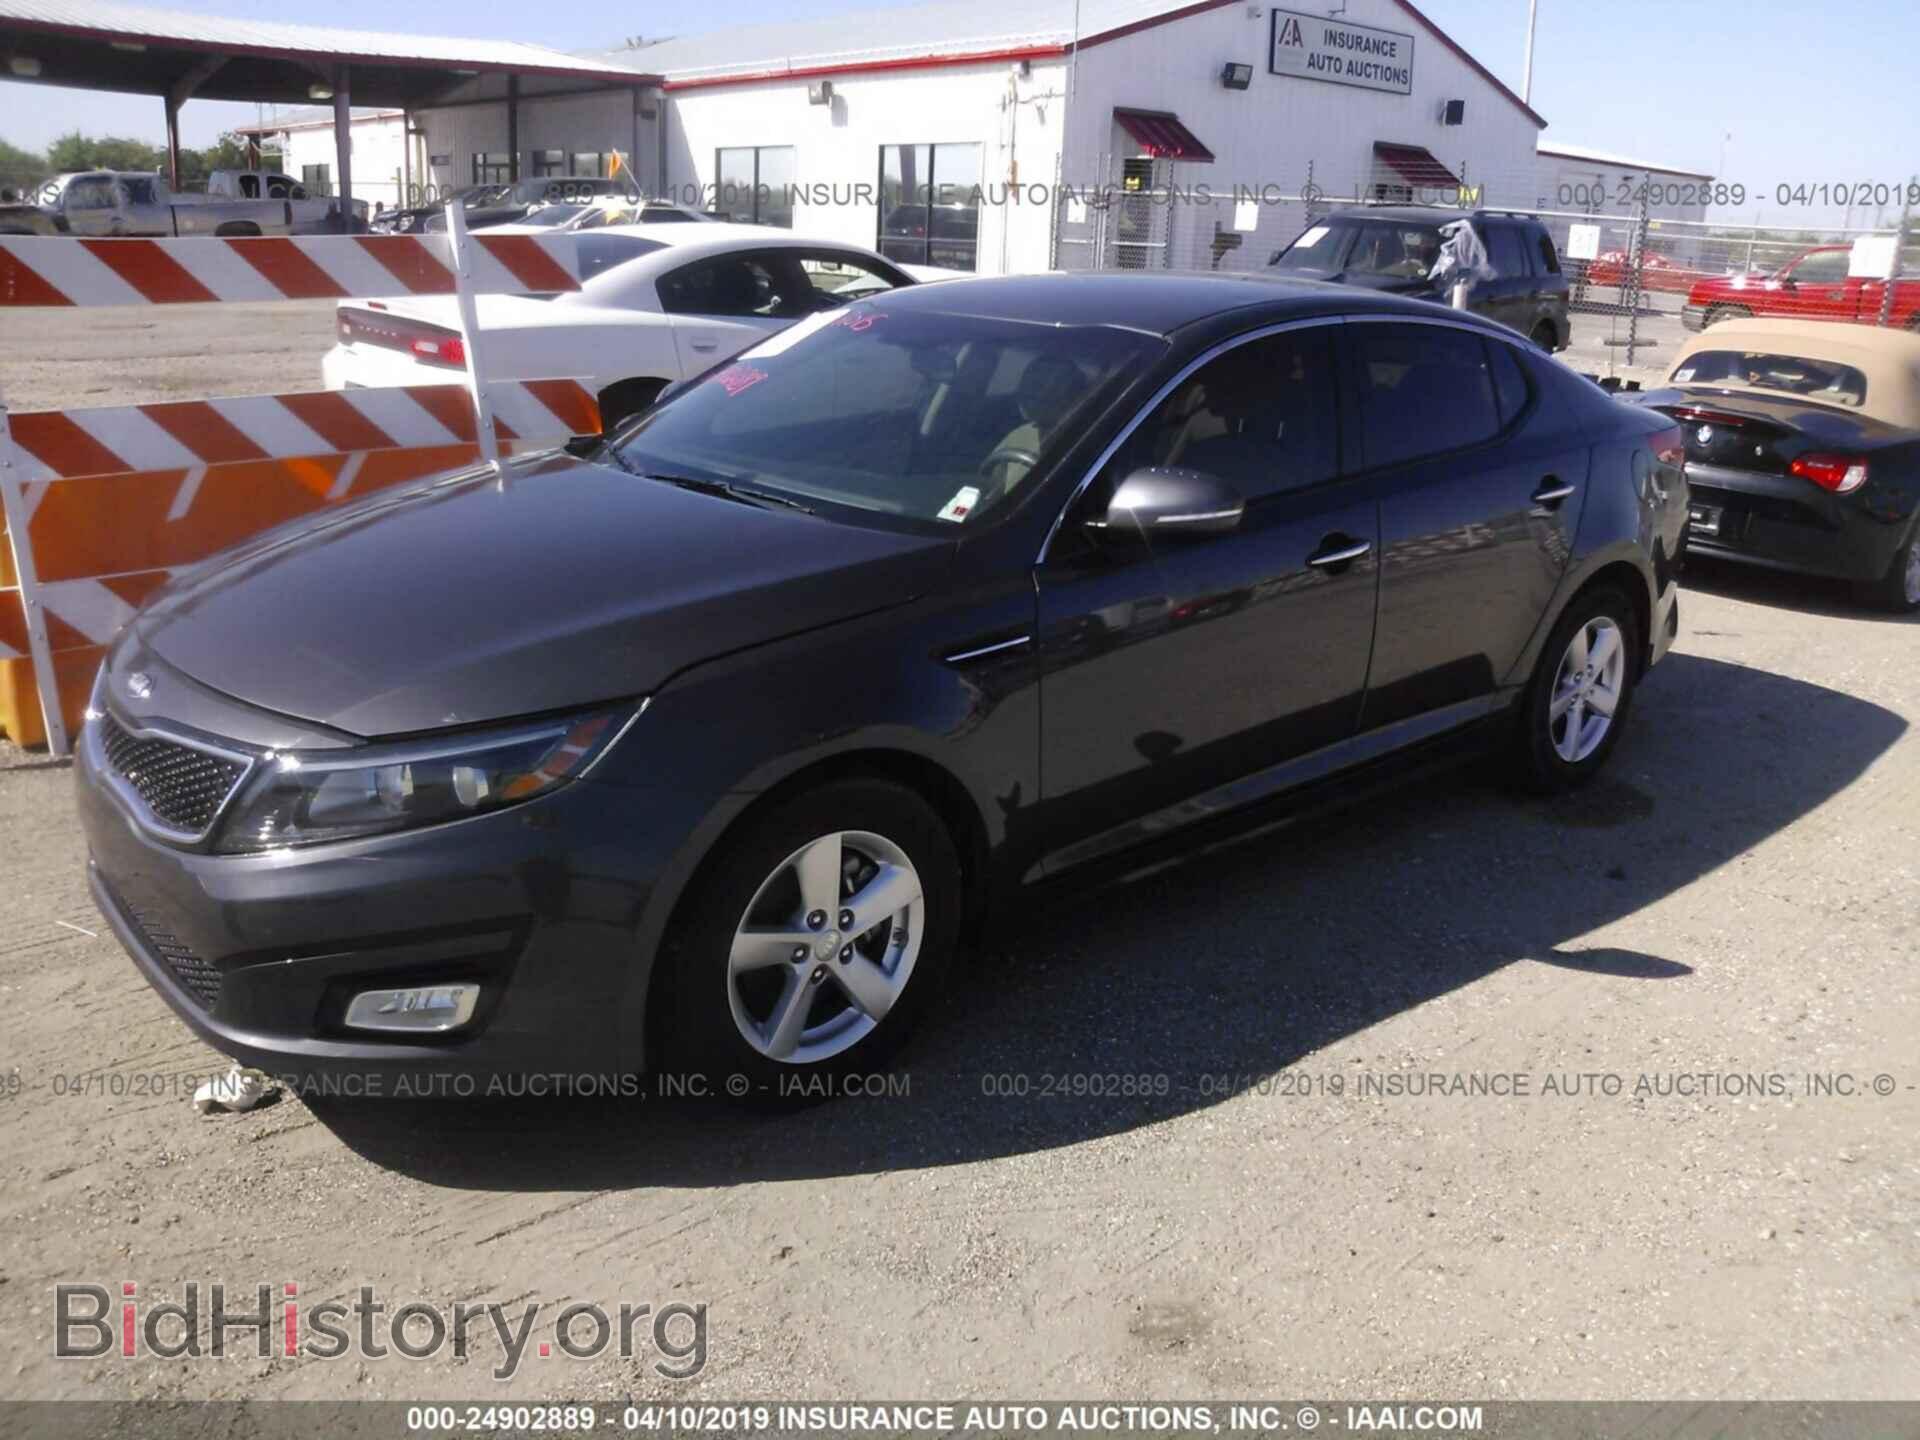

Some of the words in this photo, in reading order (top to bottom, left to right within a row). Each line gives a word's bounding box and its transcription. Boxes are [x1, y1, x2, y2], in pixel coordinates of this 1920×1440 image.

[1323, 28, 1398, 58] INSURANCE
[1307, 52, 1343, 74] AUTO
[1346, 59, 1409, 86] AUCTIONS
